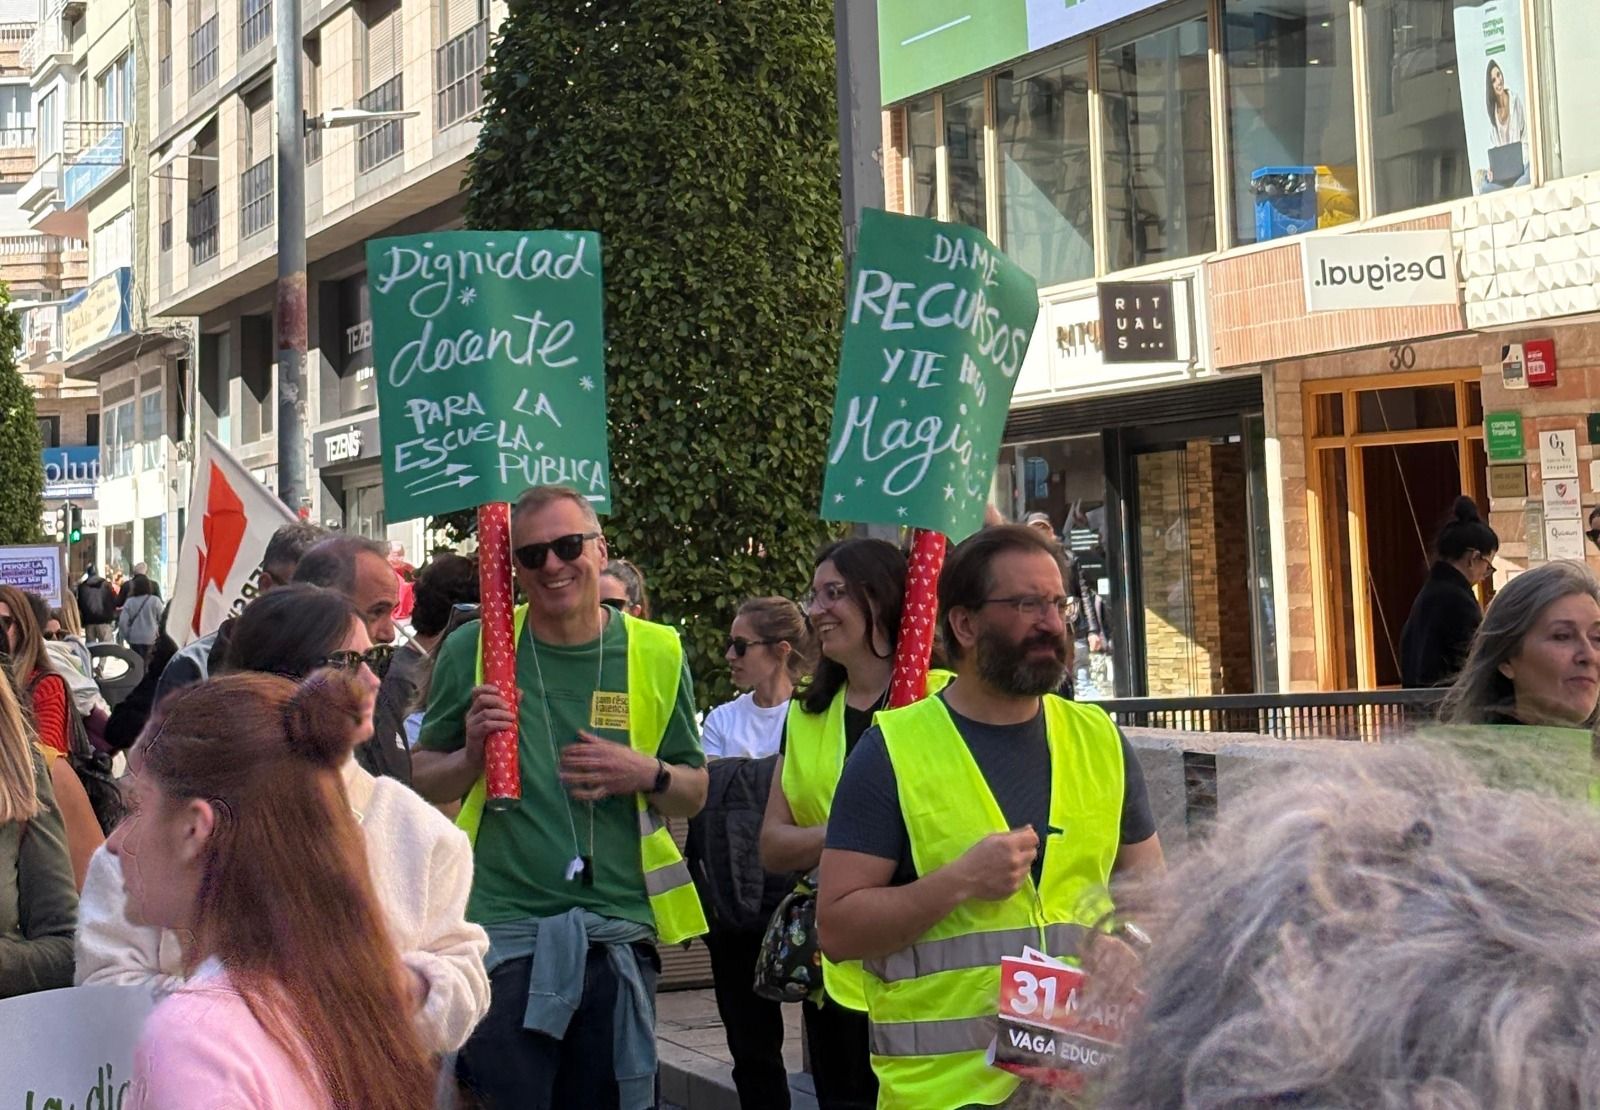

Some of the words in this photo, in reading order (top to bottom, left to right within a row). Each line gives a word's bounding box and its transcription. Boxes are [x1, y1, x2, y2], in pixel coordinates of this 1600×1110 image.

[375, 237, 594, 318] Dignidad
[925, 233, 999, 287] DAME
[389, 310, 579, 388] docente
[850, 269, 1026, 378] RECURSOS
[1389, 345, 1416, 371] 30
[404, 391, 486, 434] PARA
[513, 388, 562, 427] LA
[1010, 971, 1057, 1020] 31
[1009, 1029, 1056, 1056] VAGA
